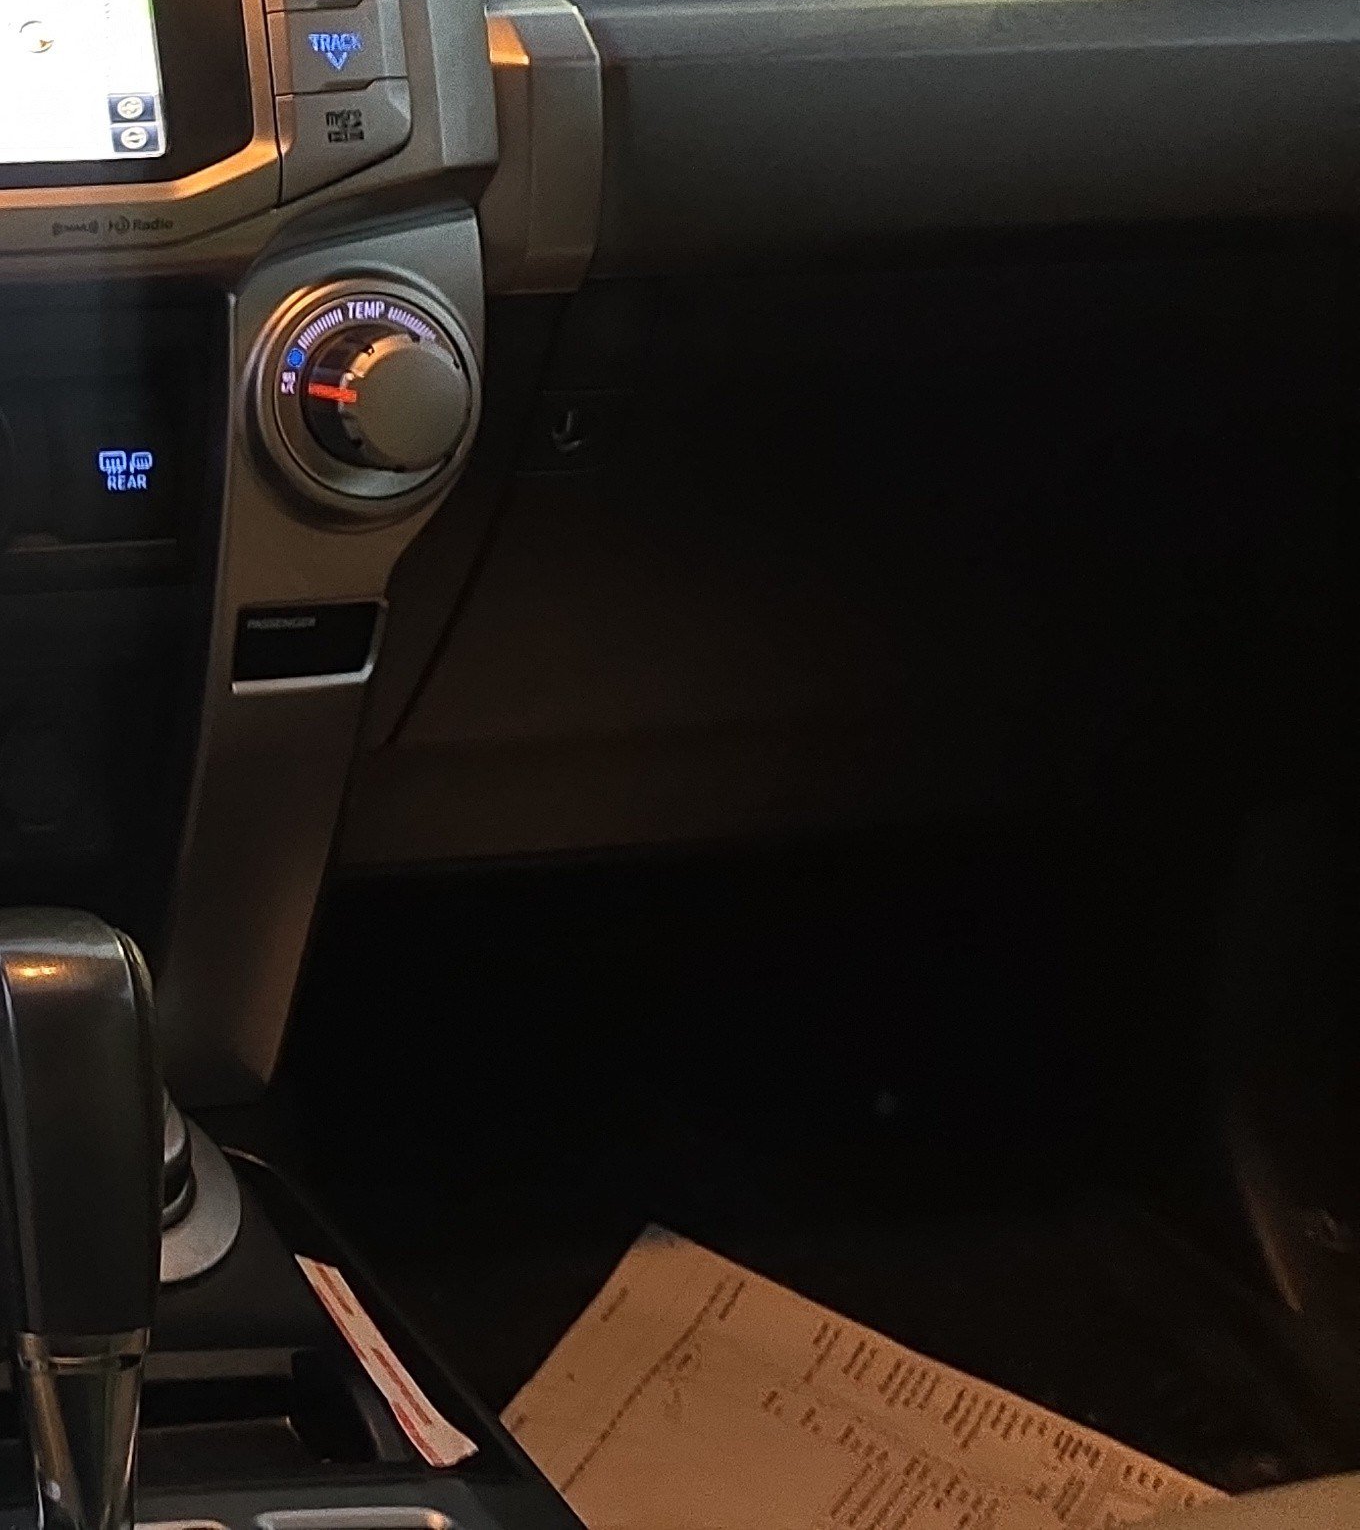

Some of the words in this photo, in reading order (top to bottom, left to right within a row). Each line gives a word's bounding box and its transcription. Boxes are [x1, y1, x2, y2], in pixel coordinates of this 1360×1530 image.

[309, 33, 363, 52] TRACK
[346, 300, 386, 321] TEMP
[106, 474, 148, 491] REAR
